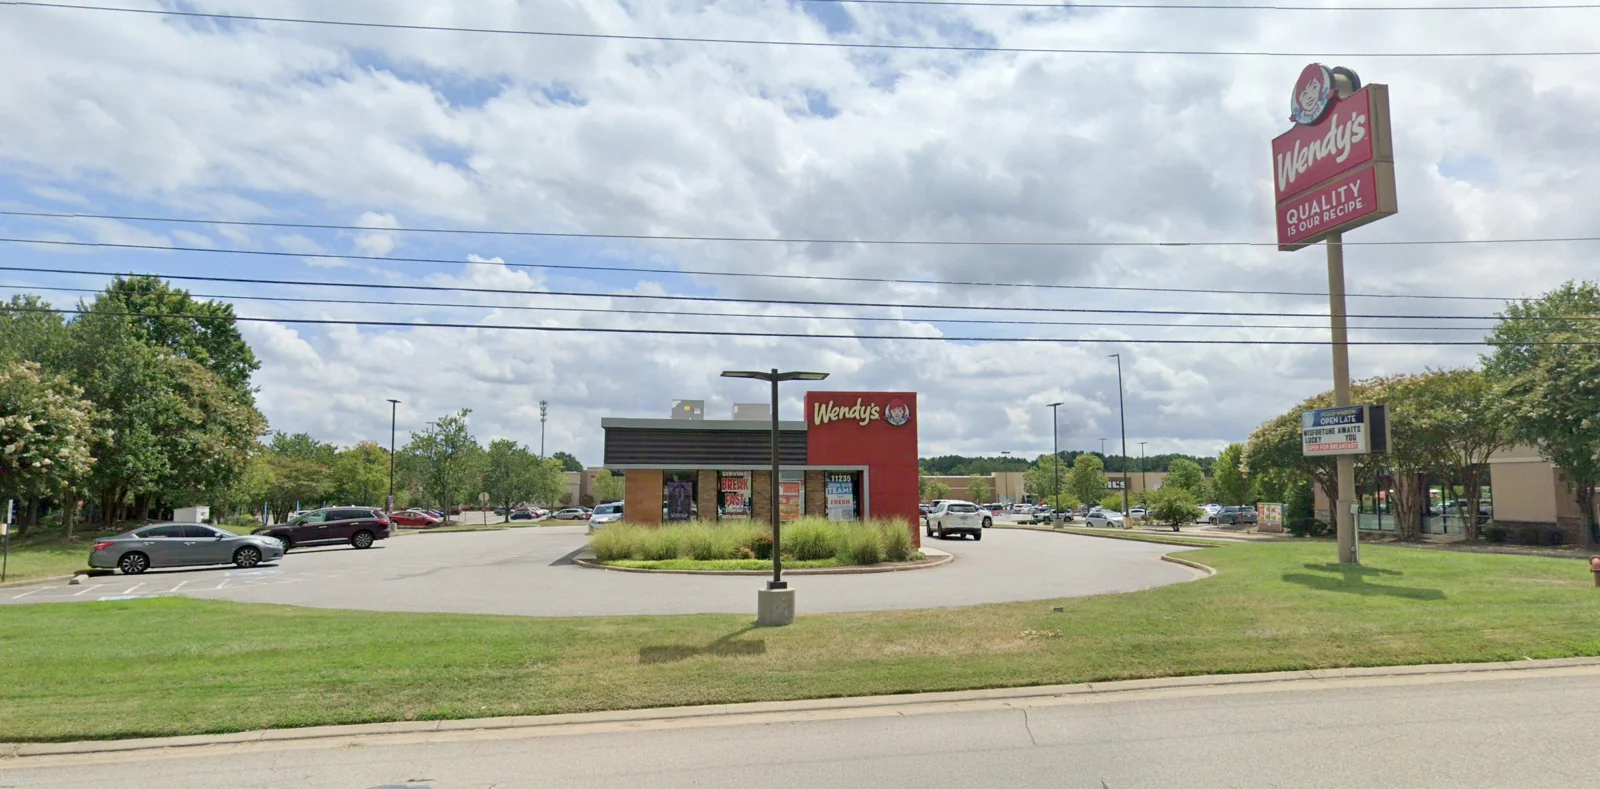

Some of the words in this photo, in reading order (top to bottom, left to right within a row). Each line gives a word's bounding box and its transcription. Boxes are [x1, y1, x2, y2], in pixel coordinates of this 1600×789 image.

[1277, 111, 1366, 192] Wendy's
[1286, 180, 1361, 225] QUALITY
[1287, 225, 1296, 237] IS
[1298, 217, 1320, 232] OUR
[1323, 198, 1363, 222] RECIPE
[814, 397, 880, 426] Wendy's
[1320, 416, 1338, 425] OPEN
[1339, 415, 1356, 423] LATE
[1304, 428, 1335, 436] MISFORTUNE
[1338, 426, 1360, 434] AWAITS
[1330, 442, 1357, 450] BREAKFAST
[721, 478, 749, 490] BREAK
[831, 474, 851, 482] 11235
[725, 493, 744, 506] FAST
